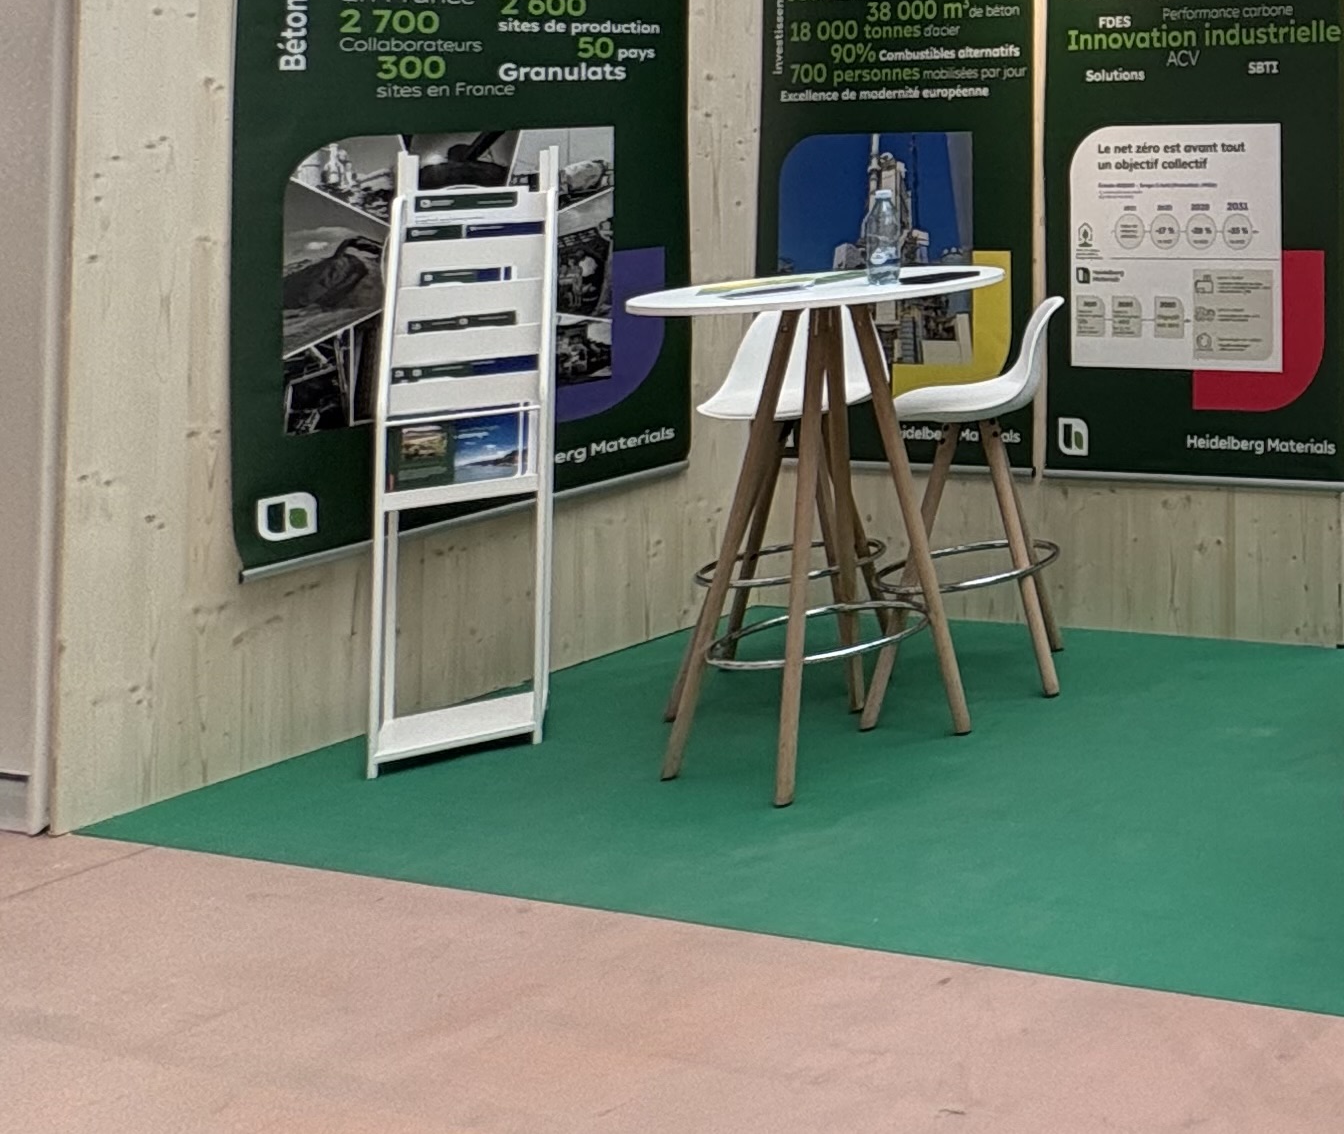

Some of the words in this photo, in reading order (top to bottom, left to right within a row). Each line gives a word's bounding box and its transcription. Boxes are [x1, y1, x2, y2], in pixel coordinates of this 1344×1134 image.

[339, 9, 362, 33] 2
[372, 10, 440, 34] 700
[866, 1, 891, 22] 38
[897, 0, 937, 20] 000
[498, 19, 538, 33] sites
[544, 19, 566, 34] de
[571, 20, 661, 36] production
[790, 21, 811, 42] 18
[816, 20, 858, 41] 000
[863, 23, 921, 39] tonnes
[1098, 15, 1131, 29] FDES
[339, 36, 483, 53] Collaborateurs
[1067, 24, 1197, 51] Innovation
[1205, 19, 1341, 46] industrielle
[577, 36, 614, 59] 50
[617, 44, 656, 62] pays
[831, 42, 876, 63] 90%
[879, 46, 956, 62] Combustibles
[1166, 50, 1200, 67] ACV
[376, 55, 446, 80] 300
[498, 62, 627, 82] Granulats
[790, 63, 828, 84] 700
[833, 66, 921, 87] personnes
[1085, 68, 1146, 83] Solutions
[1248, 61, 1279, 75] SBTI
[376, 83, 421, 99] sites
[427, 86, 450, 98] en
[455, 82, 516, 97] France
[591, 427, 676, 456] Materials
[1186, 433, 1265, 455] Heidelberg
[1267, 436, 1336, 455] Materials
